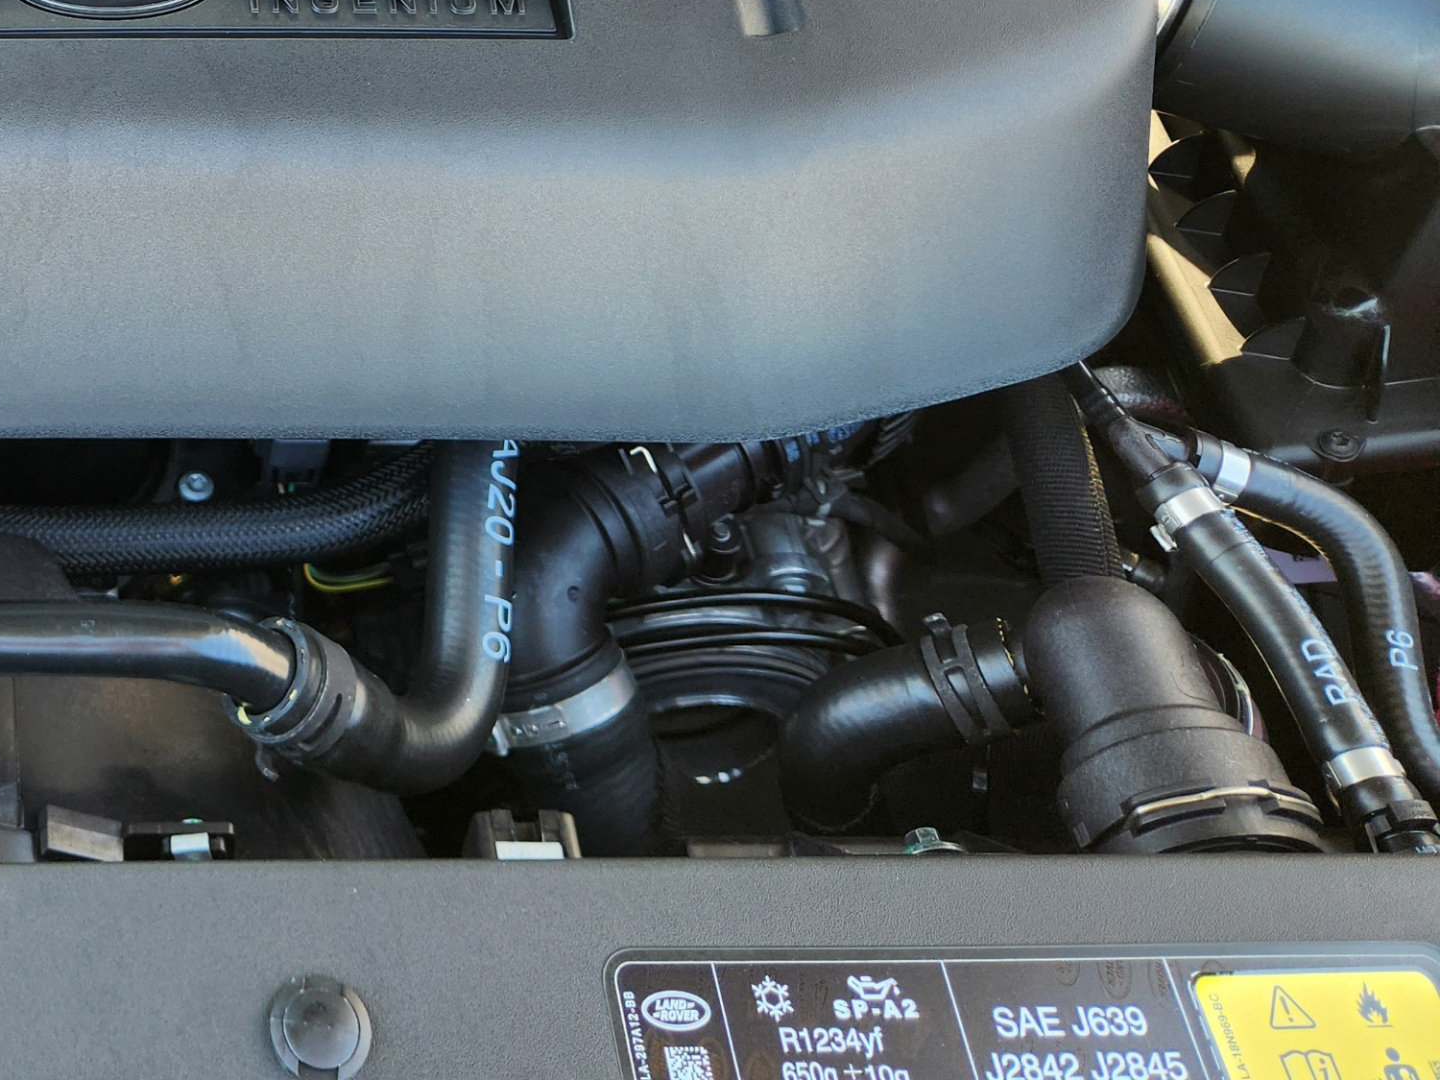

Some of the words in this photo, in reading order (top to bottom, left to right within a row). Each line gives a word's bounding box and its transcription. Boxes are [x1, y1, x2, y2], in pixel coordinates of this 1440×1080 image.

[485, 440, 521, 547] AJ20
[482, 593, 514, 664] P6
[1384, 629, 1420, 672] P6
[1300, 637, 1359, 707] RAD
[655, 998, 688, 1011] LAND
[660, 1009, 700, 1022] ROVER
[832, 998, 920, 1020] SP-A2
[992, 1006, 1066, 1038] SAE
[1072, 1006, 1148, 1037] J639
[778, 1025, 884, 1060] R1234yf
[985, 1052, 1084, 1080] J2842
[1091, 1051, 1189, 1080] J2845
